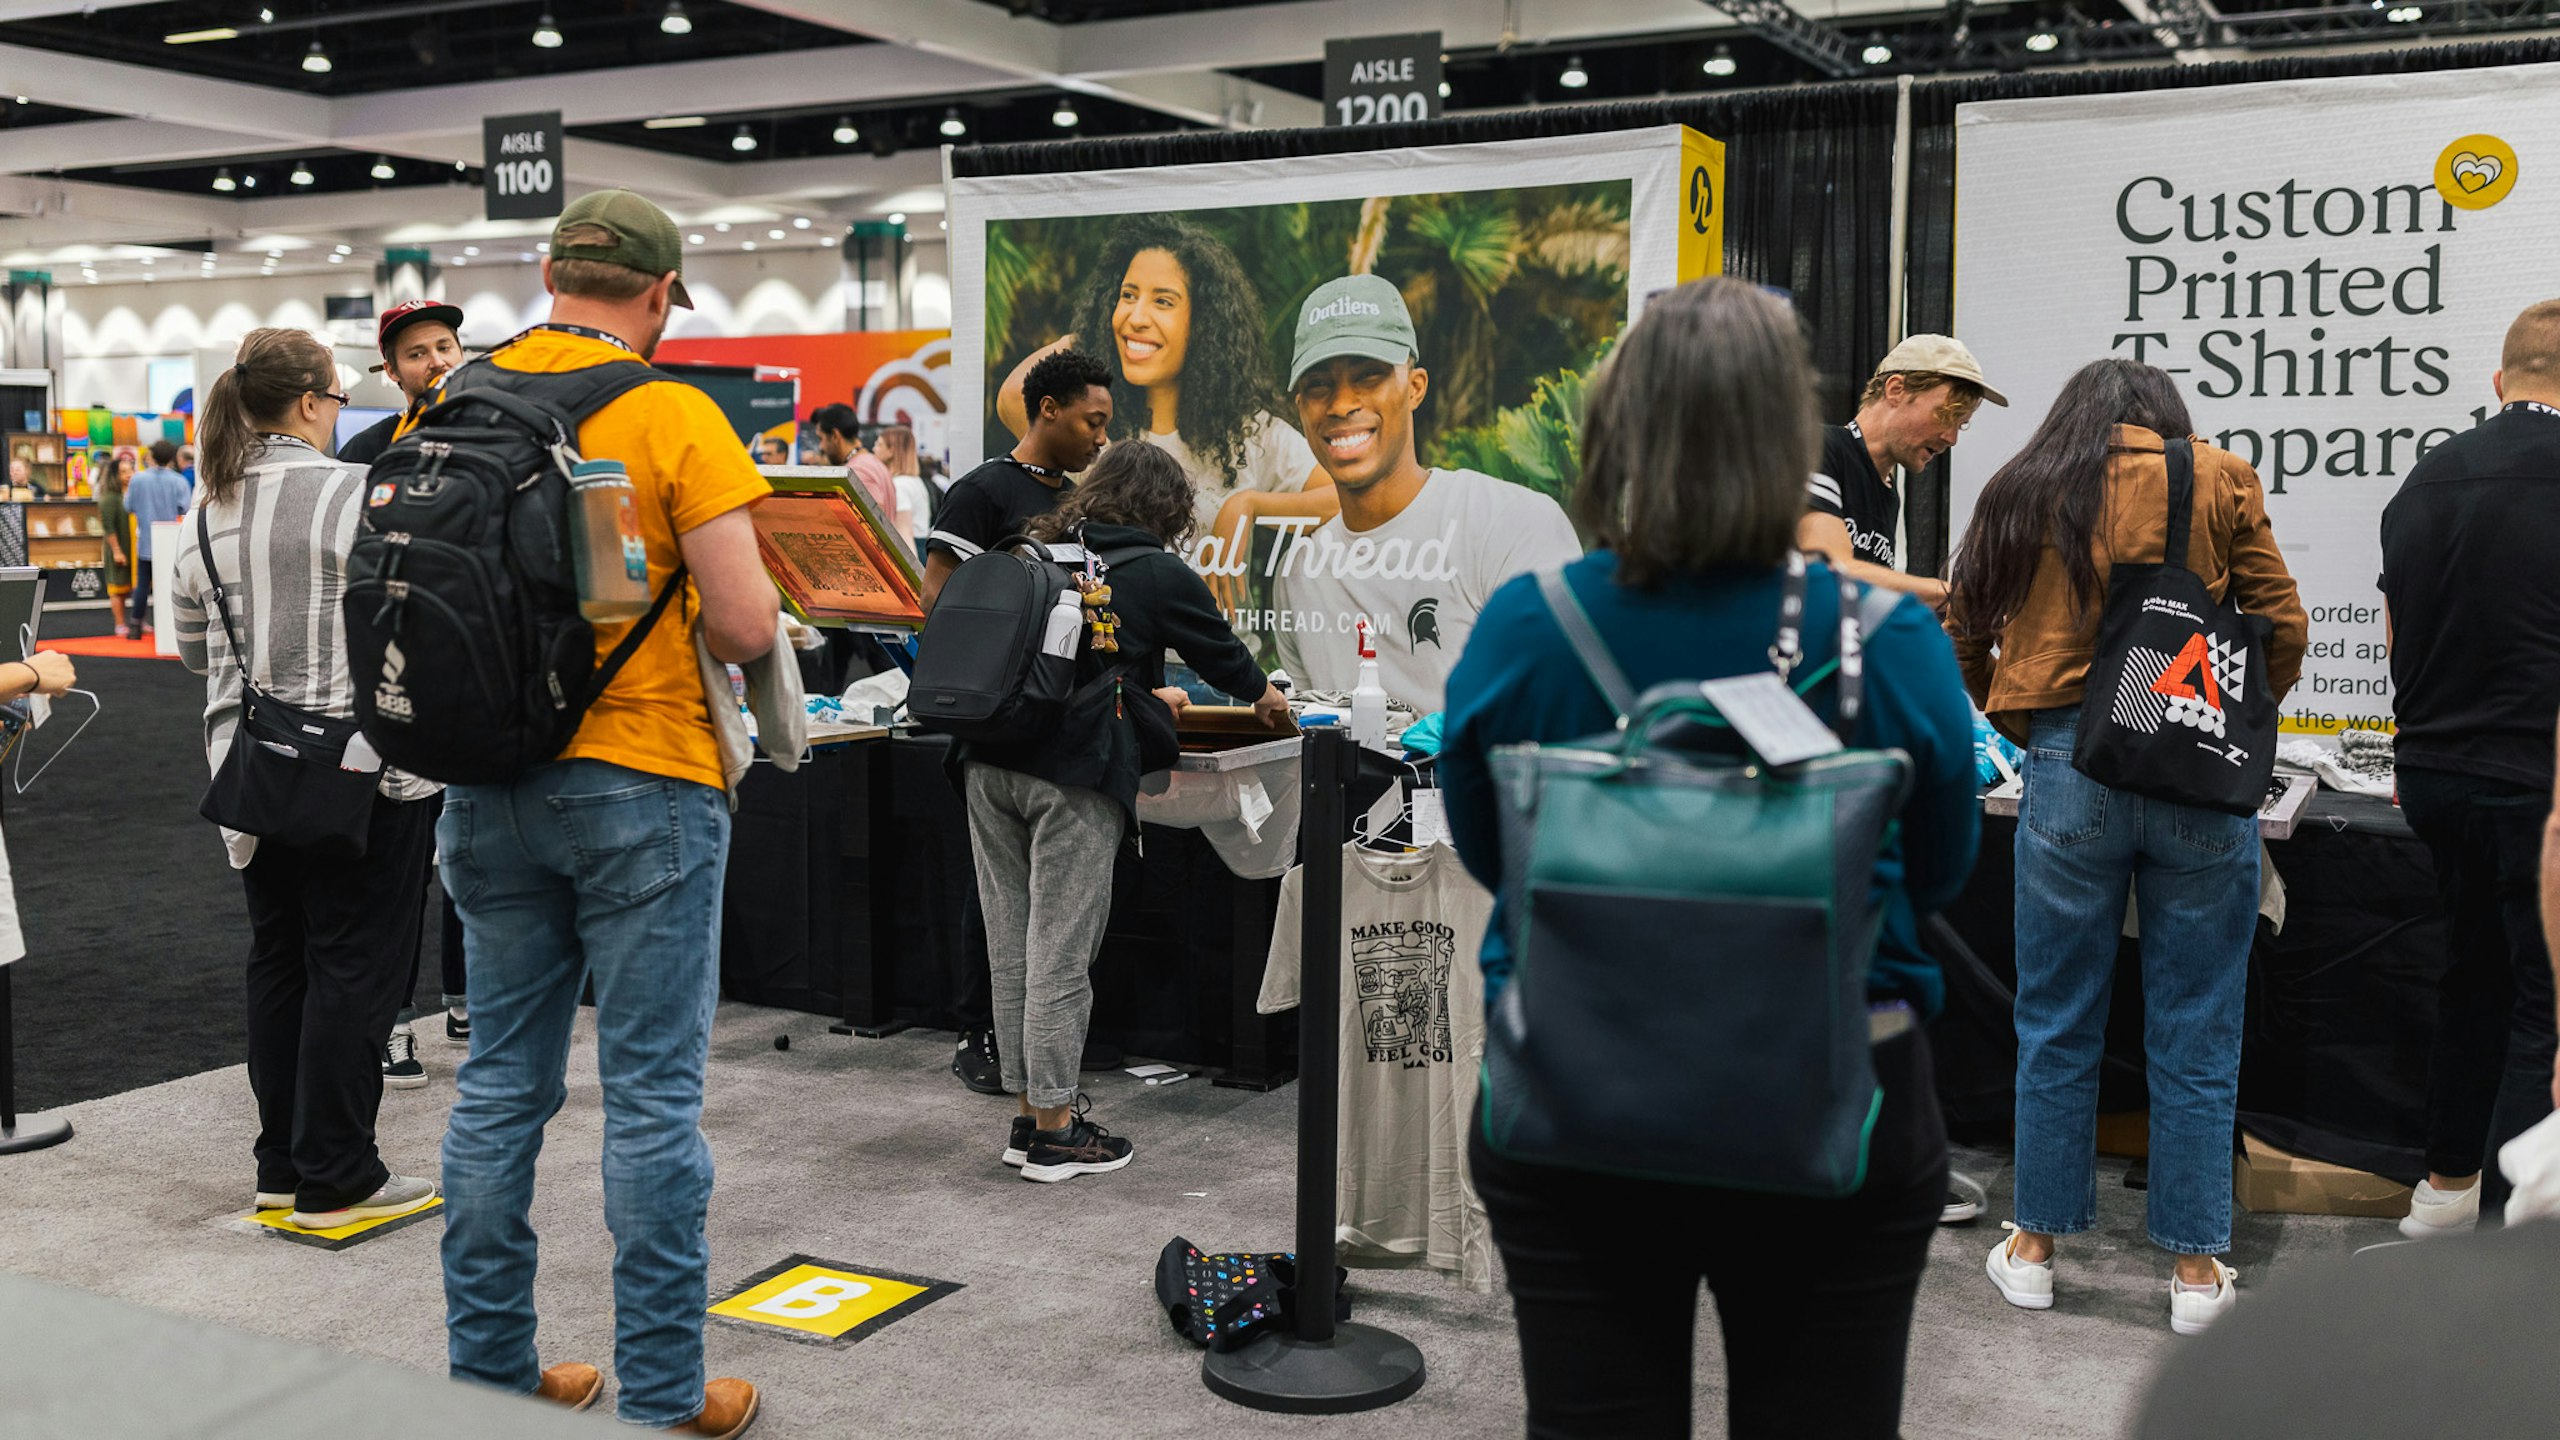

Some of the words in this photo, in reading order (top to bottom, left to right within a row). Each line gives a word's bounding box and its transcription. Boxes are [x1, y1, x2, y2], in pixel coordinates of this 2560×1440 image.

[1350, 57, 1415, 84] AISLE
[1336, 91, 1428, 127] 1200
[500, 130, 546, 155] AISLE
[494, 158, 553, 196] 1100
[2116, 175, 2457, 244] Custom
[2124, 243, 2445, 322] Printed
[1308, 295, 1380, 326] Outliers
[1255, 516, 1459, 582] Thread
[2167, 599, 2189, 611] MAX
[2311, 603, 2381, 624] order
[2313, 673, 2388, 696] brand
[2294, 708, 2336, 729] the
[1351, 921, 1406, 940] MAKE
[1367, 1045, 1412, 1063] FEEL
[746, 1275, 873, 1319] B
